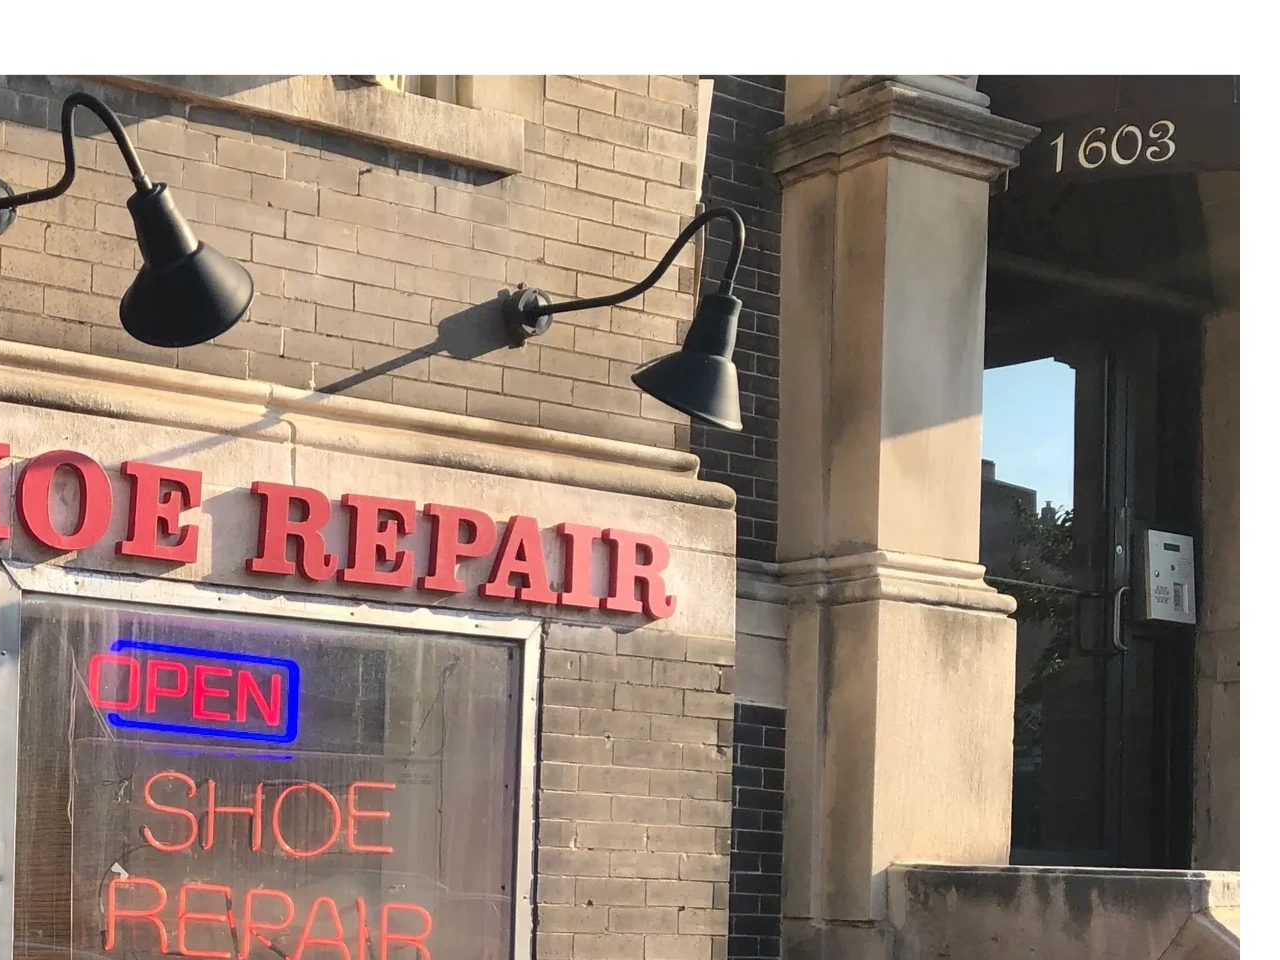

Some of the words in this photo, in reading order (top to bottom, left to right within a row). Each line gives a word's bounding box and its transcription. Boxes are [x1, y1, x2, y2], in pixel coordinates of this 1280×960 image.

[1050, 120, 1177, 174] 1603
[246, 480, 677, 619] REPAIR
[88, 654, 282, 727] OPEN
[140, 771, 396, 858] SHOE
